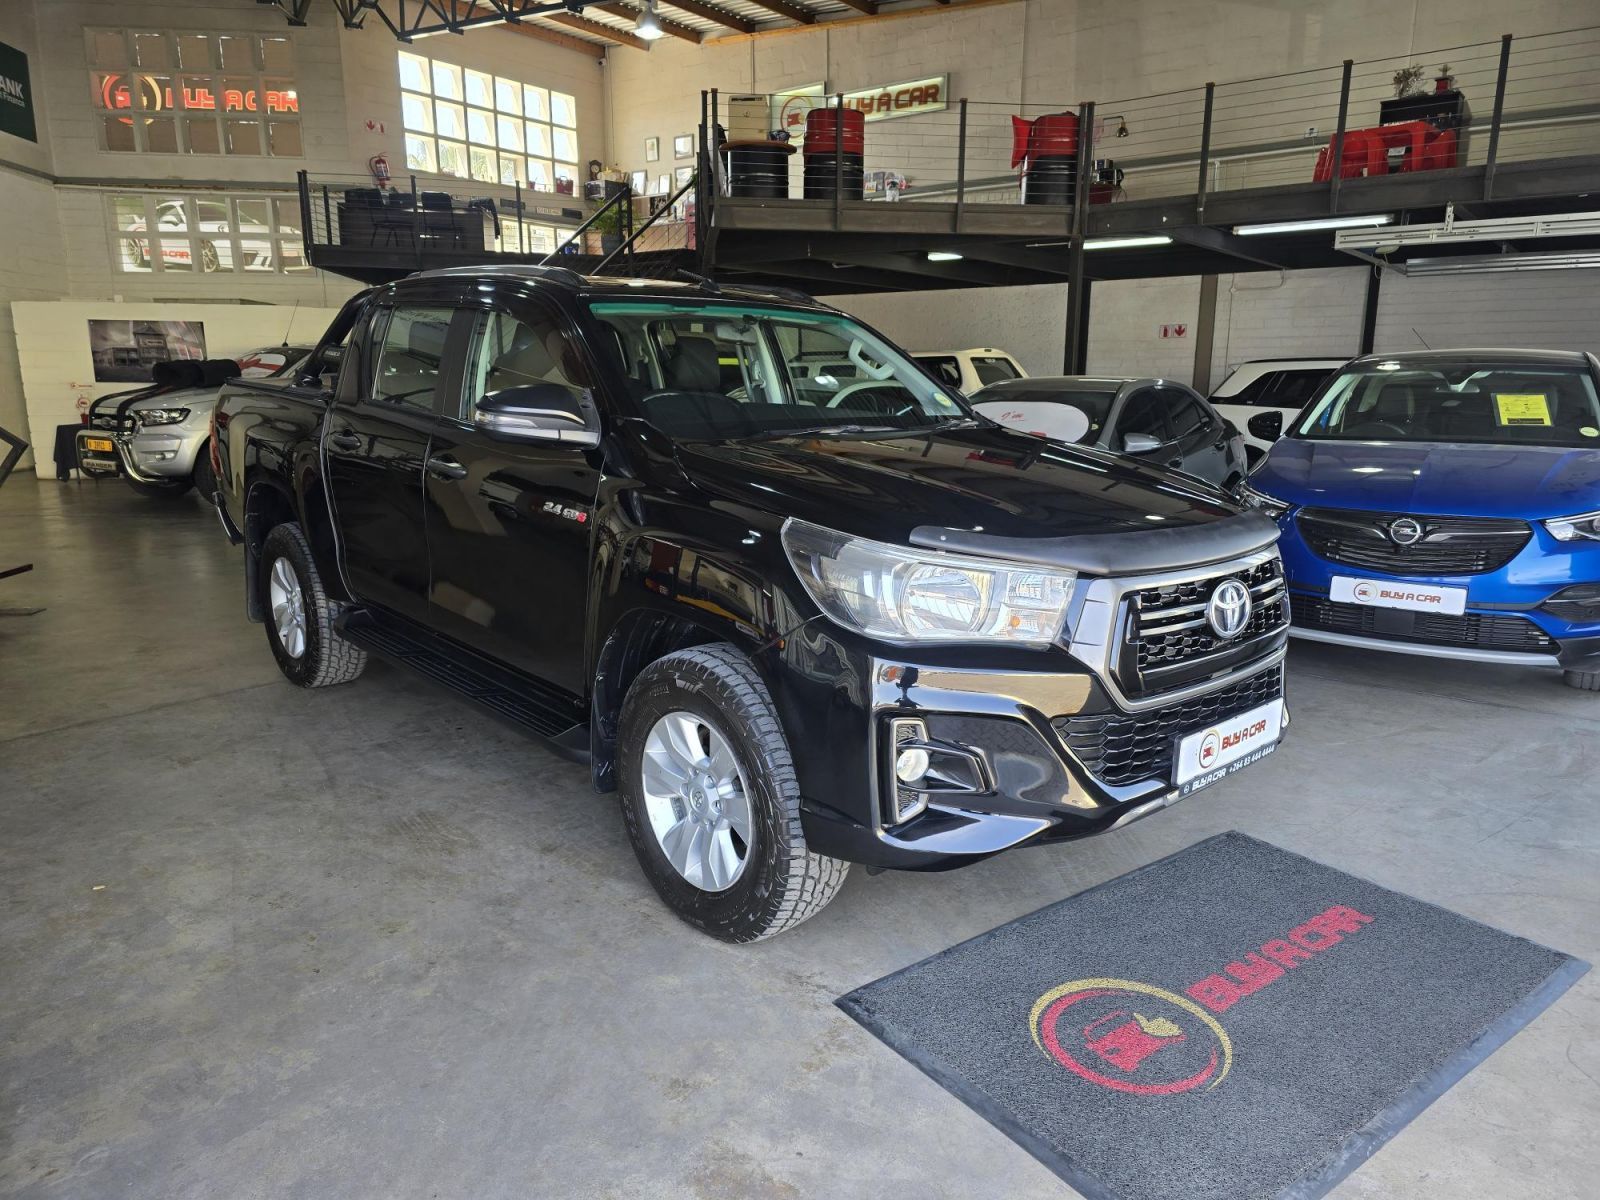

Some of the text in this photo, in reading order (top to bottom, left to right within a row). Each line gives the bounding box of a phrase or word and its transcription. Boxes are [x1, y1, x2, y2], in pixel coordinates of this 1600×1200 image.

[224, 89, 243, 111] A
[877, 92, 892, 112] A
[895, 83, 939, 109] CAR
[1380, 590, 1442, 603] BUY A CAR
[1221, 719, 1267, 750] BUY A CAR
[1213, 768, 1227, 781] CAR
[1185, 904, 1376, 1014] BUY A CAR
